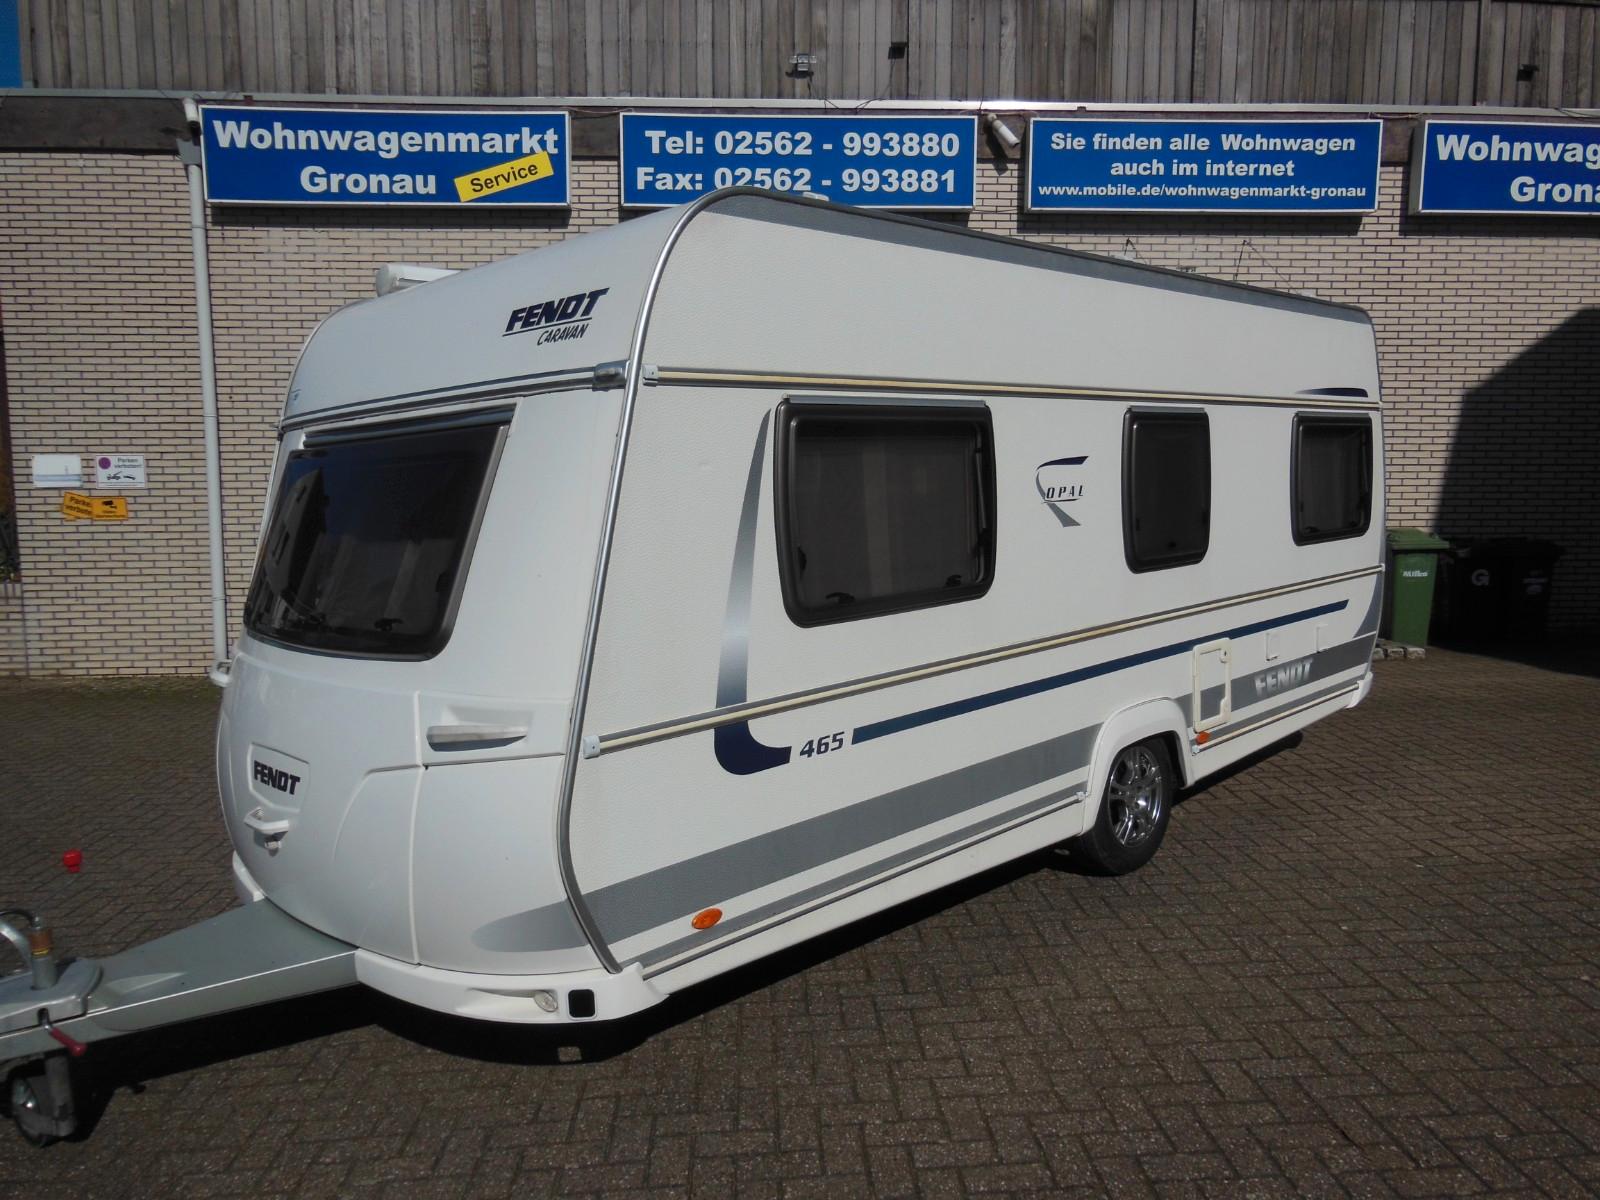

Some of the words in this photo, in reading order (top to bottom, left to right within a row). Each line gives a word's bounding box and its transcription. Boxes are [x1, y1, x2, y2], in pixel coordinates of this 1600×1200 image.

[212, 119, 559, 159] Wohnwagenmarkt
[645, 130, 704, 155] Tel:
[714, 131, 813, 156] 02562
[842, 132, 960, 157] 993880
[1051, 133, 1086, 151] Sie
[1093, 133, 1162, 151] finden
[1169, 133, 1210, 151] alle
[1221, 133, 1356, 156] Wohnwagen
[300, 165, 437, 195] Gronau
[469, 161, 539, 194] Service
[636, 167, 704, 191] Fax:
[714, 168, 812, 192] 02562
[841, 169, 956, 193] 993881
[1110, 159, 1165, 176] auch
[1172, 160, 1198, 176] im
[1205, 160, 1295, 177] internet
[1038, 183, 1367, 199] www.mobile.de/wohnwagenmarkt-gronau
[1510, 176, 1600, 203] Gron
[505, 287, 610, 333] FENDT
[537, 323, 589, 346] CARAVAN
[1046, 485, 1084, 499] OPAL
[1254, 657, 1314, 697] FENDT
[799, 731, 845, 758] 465
[253, 760, 301, 795] FENDT
